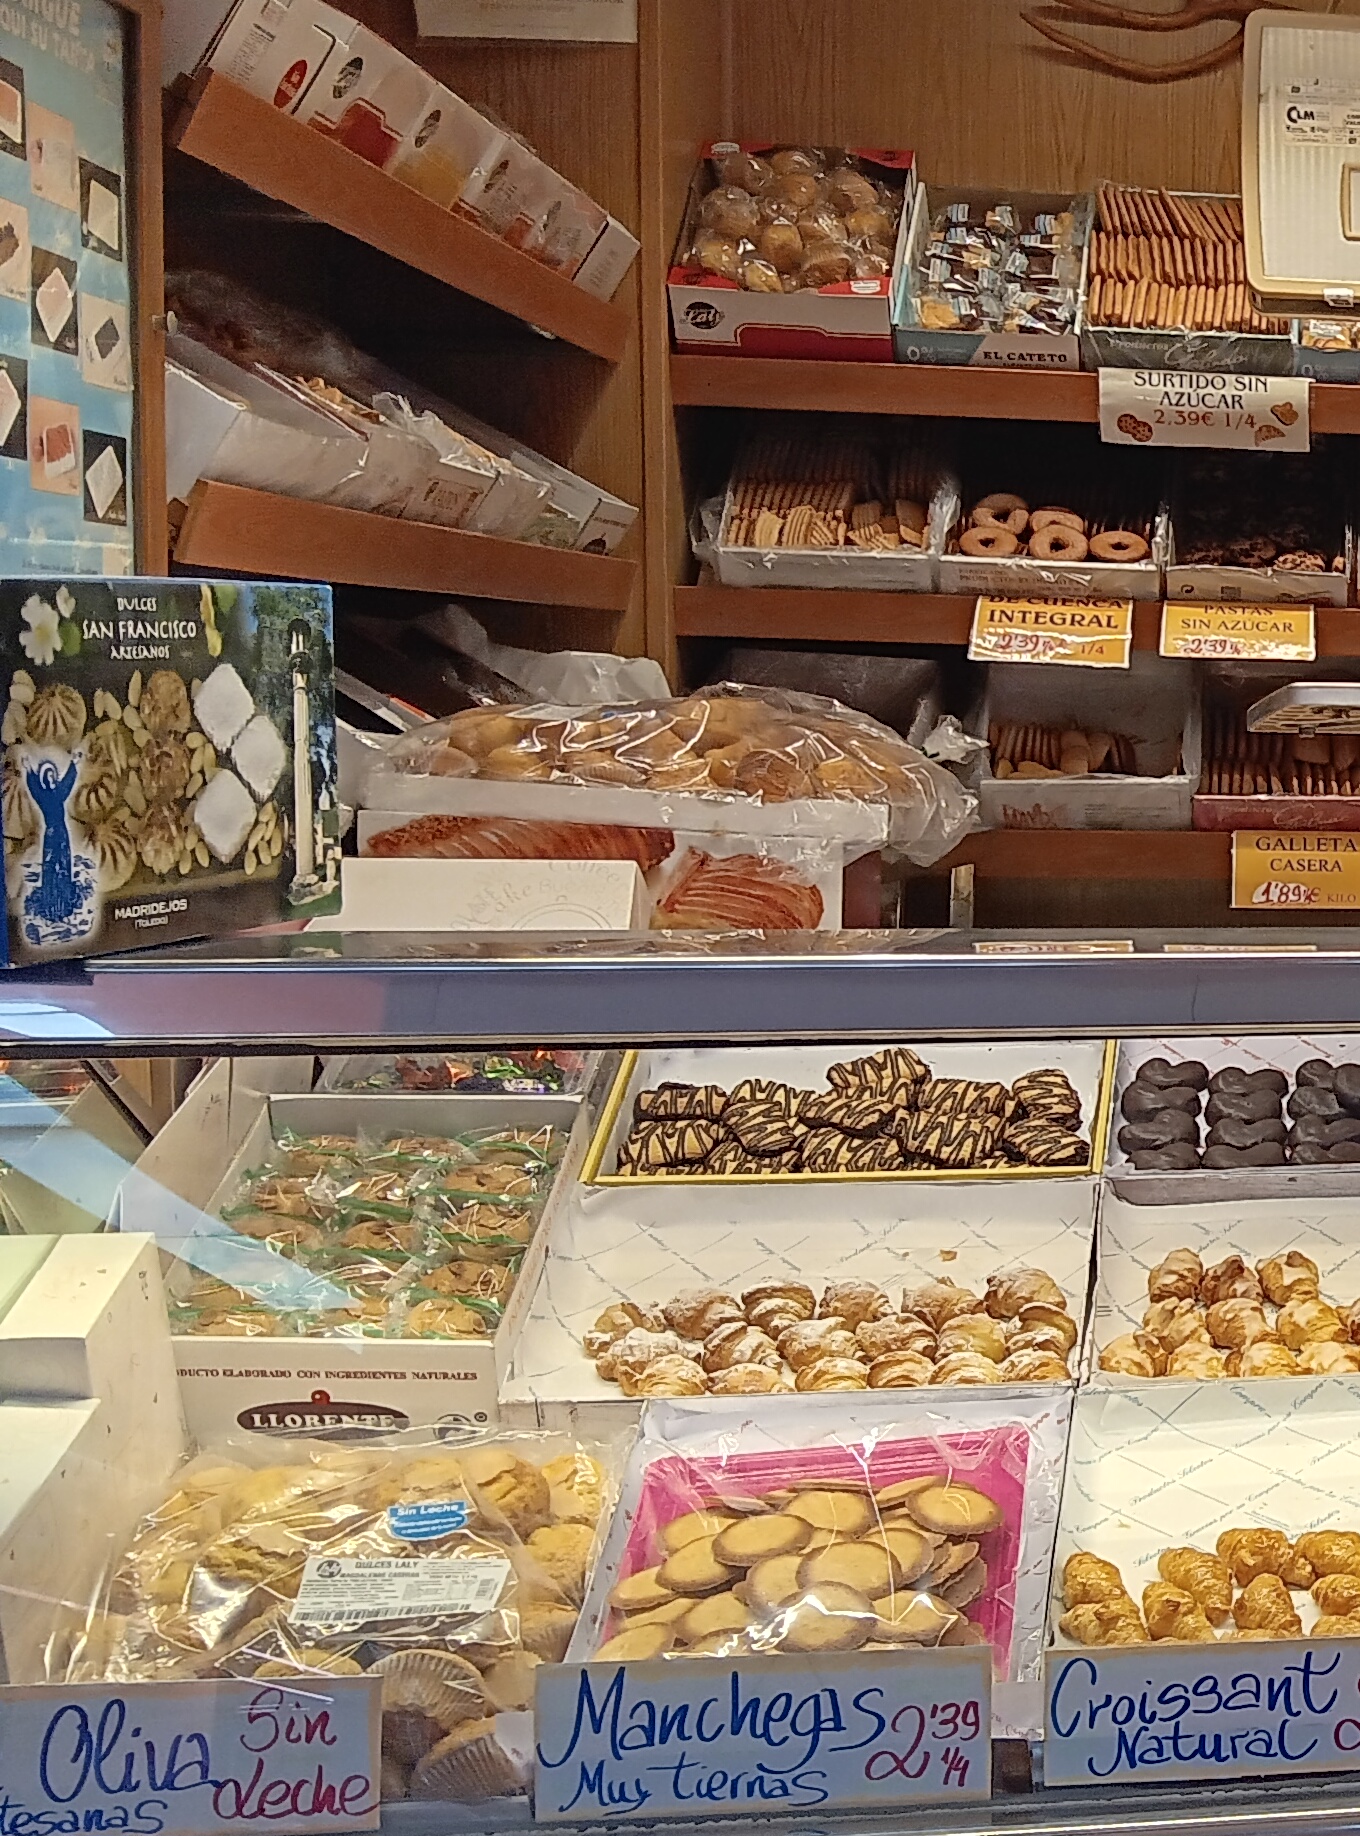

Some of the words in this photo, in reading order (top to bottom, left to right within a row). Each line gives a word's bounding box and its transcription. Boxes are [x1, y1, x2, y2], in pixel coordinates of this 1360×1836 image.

[983, 351, 1002, 360] EL
[1007, 352, 1067, 363] CATETO
[1133, 371, 1226, 391] SURTIDO
[1233, 376, 1268, 393] SIN
[1159, 389, 1245, 410] AZÚCAR
[1225, 411, 1257, 431] 1/4
[117, 597, 157, 611] DULCES
[988, 609, 1119, 629] INTEGRAL
[1181, 618, 1211, 629] SIN
[83, 619, 114, 639] SAN
[118, 620, 197, 641] FRANCISCO
[111, 645, 170, 660] ARTESANOS
[1255, 836, 1358, 853] GALLETA
[1270, 858, 1343, 873] CASERA
[1327, 893, 1357, 904] KILO
[115, 899, 187, 920] MADRIDEJOS
[223, 1369, 292, 1379] ELABORADO
[297, 1370, 321, 1379] CON
[325, 1370, 407, 1380] INGREDIENTES
[411, 1372, 478, 1381] NATURALES
[252, 1413, 394, 1428] LLORENTE
[355, 1561, 392, 1569] DULCES
[395, 1561, 419, 1569] LALY
[1050, 1651, 1341, 1738] Croissant
[240, 1688, 337, 1752] Sin
[536, 1666, 887, 1773] Manchegas
[864, 1700, 981, 1782] 2'39
[40, 1699, 213, 1803] Oliva
[1088, 1719, 1318, 1776] Natural
[940, 1747, 968, 1787] 1/4
[0, 1799, 168, 1836] tesanas
